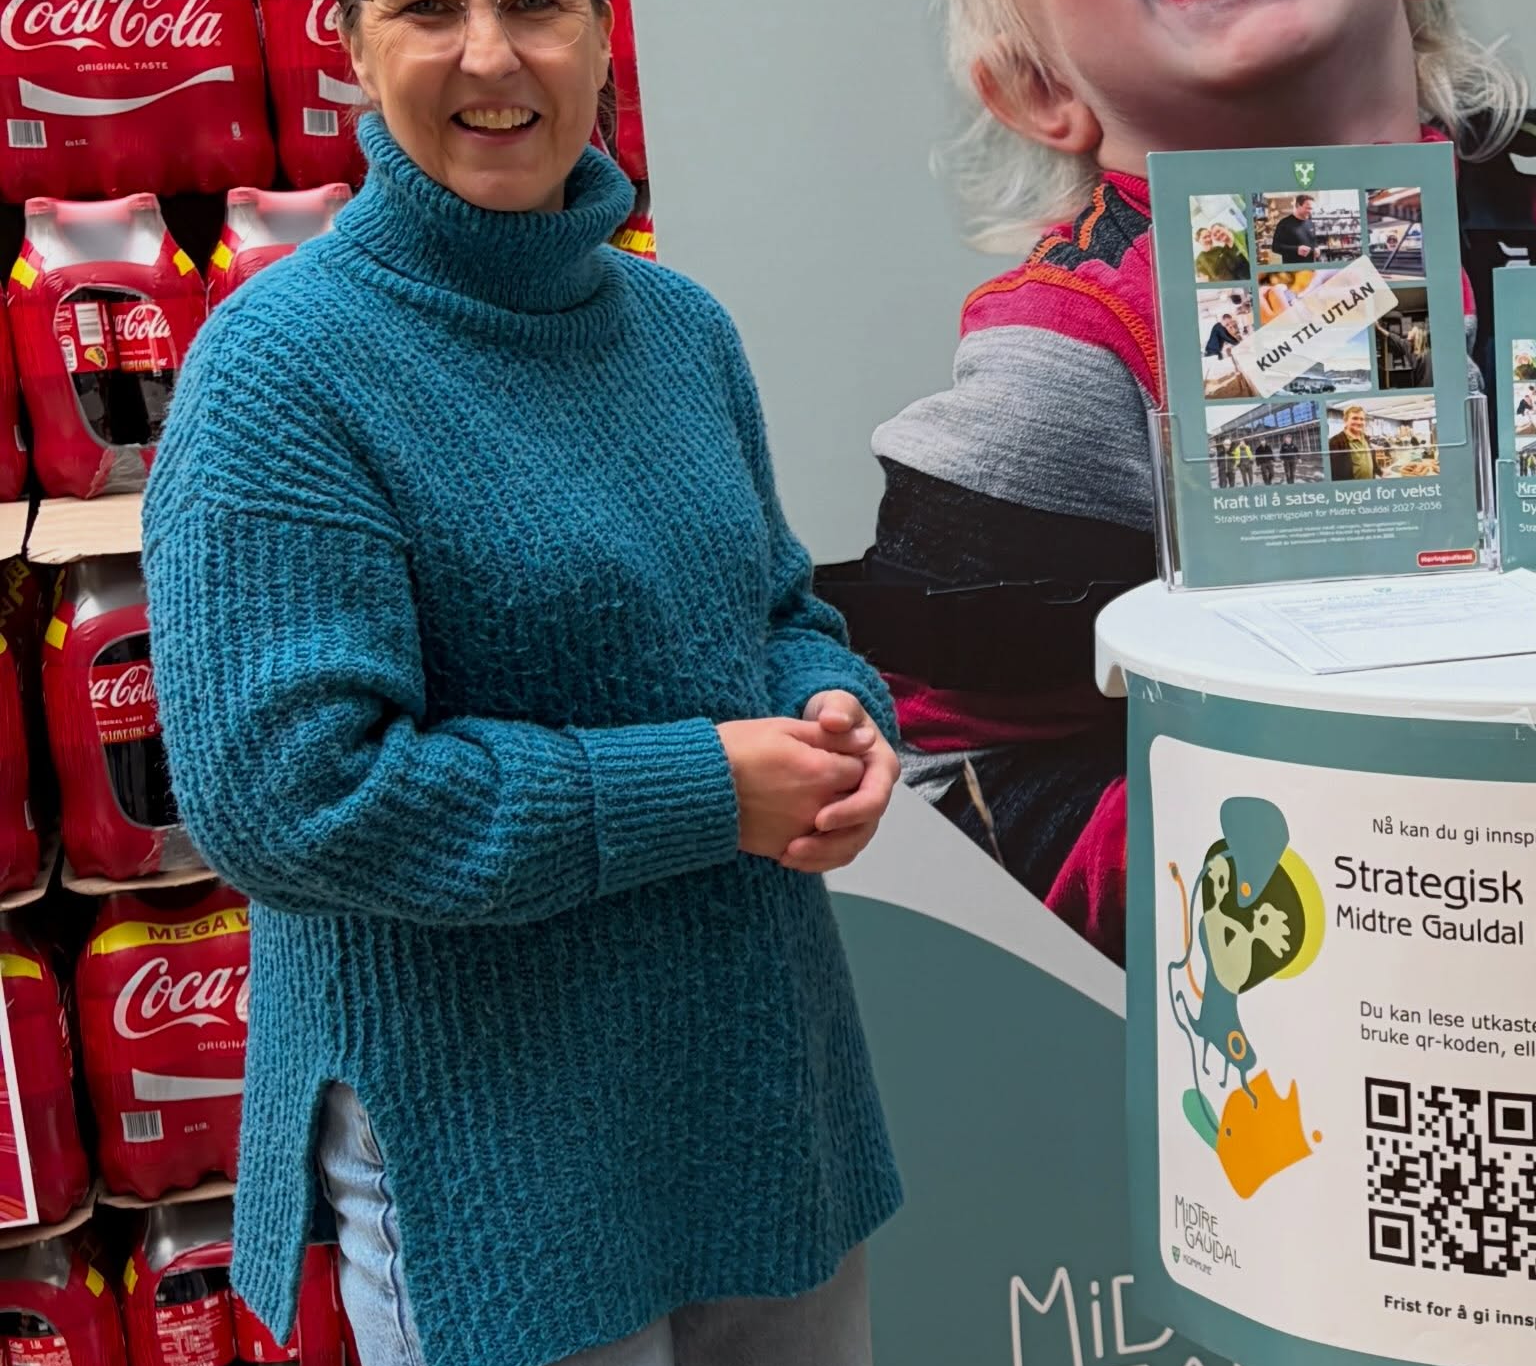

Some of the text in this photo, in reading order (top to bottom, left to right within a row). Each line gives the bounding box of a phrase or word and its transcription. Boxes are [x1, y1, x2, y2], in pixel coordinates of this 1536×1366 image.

[77, 62, 168, 72] ORIGINAL TASTE
[1256, 282, 1375, 371] KUN TIL UTLÅN
[1214, 484, 1442, 510] Kraft til å satse, bygd for vekst
[1214, 514, 1258, 525] Strategisk
[1260, 510, 1313, 522] næringsplan
[1316, 508, 1327, 517] for
[1329, 506, 1356, 516] Midtre
[1358, 505, 1390, 515] Gauldal
[1372, 816, 1394, 835] Nå
[1400, 820, 1430, 839] kan
[1436, 823, 1457, 841] du
[1464, 826, 1480, 846] gi
[1334, 856, 1524, 911] Strategisk
[147, 915, 221, 941] MEGA
[1337, 905, 1413, 936] Midtre
[1422, 914, 1525, 945] Gauldal
[113, 956, 249, 1040] Coca-
[1360, 1001, 1384, 1020] Du
[1391, 1005, 1422, 1024] kan
[1428, 1008, 1465, 1029] lese
[198, 1039, 248, 1051] ORIGINA
[1360, 1025, 1410, 1047] bruke
[1416, 1031, 1507, 1060] qr-koden,
[1185, 1225, 1241, 1268] GAULDAL
[1384, 1295, 1422, 1313] Frist
[1427, 1302, 1453, 1317] for
[1457, 1304, 1468, 1320] å
[1474, 1308, 1490, 1324] gi
